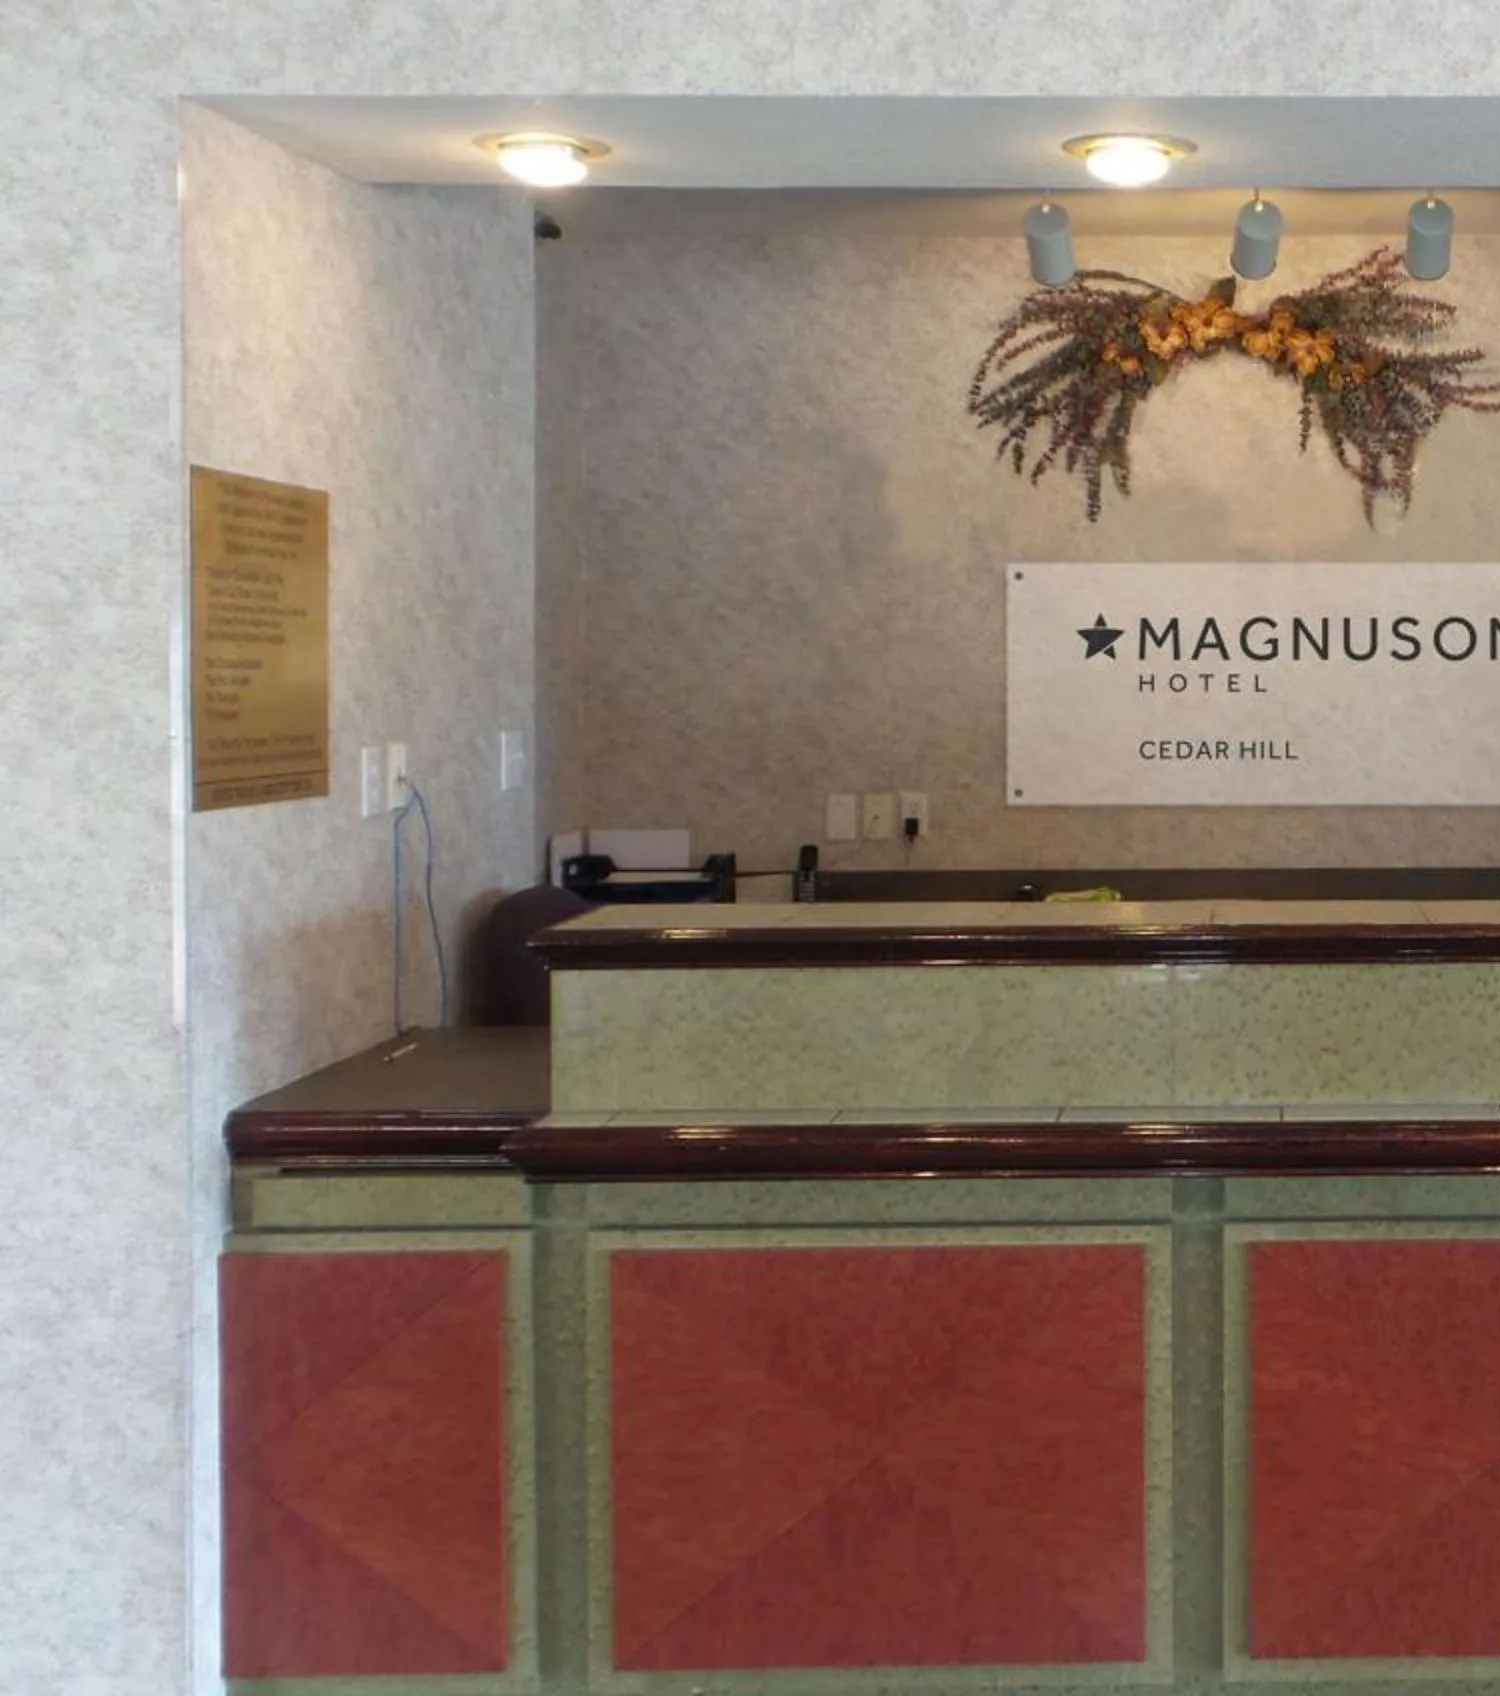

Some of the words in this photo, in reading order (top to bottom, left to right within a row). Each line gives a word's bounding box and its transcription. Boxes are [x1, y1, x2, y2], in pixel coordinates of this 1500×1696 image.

[1139, 673, 1268, 693] HOTEL
[1139, 740, 1229, 760] CEDAR
[1239, 740, 1298, 760] HILL
